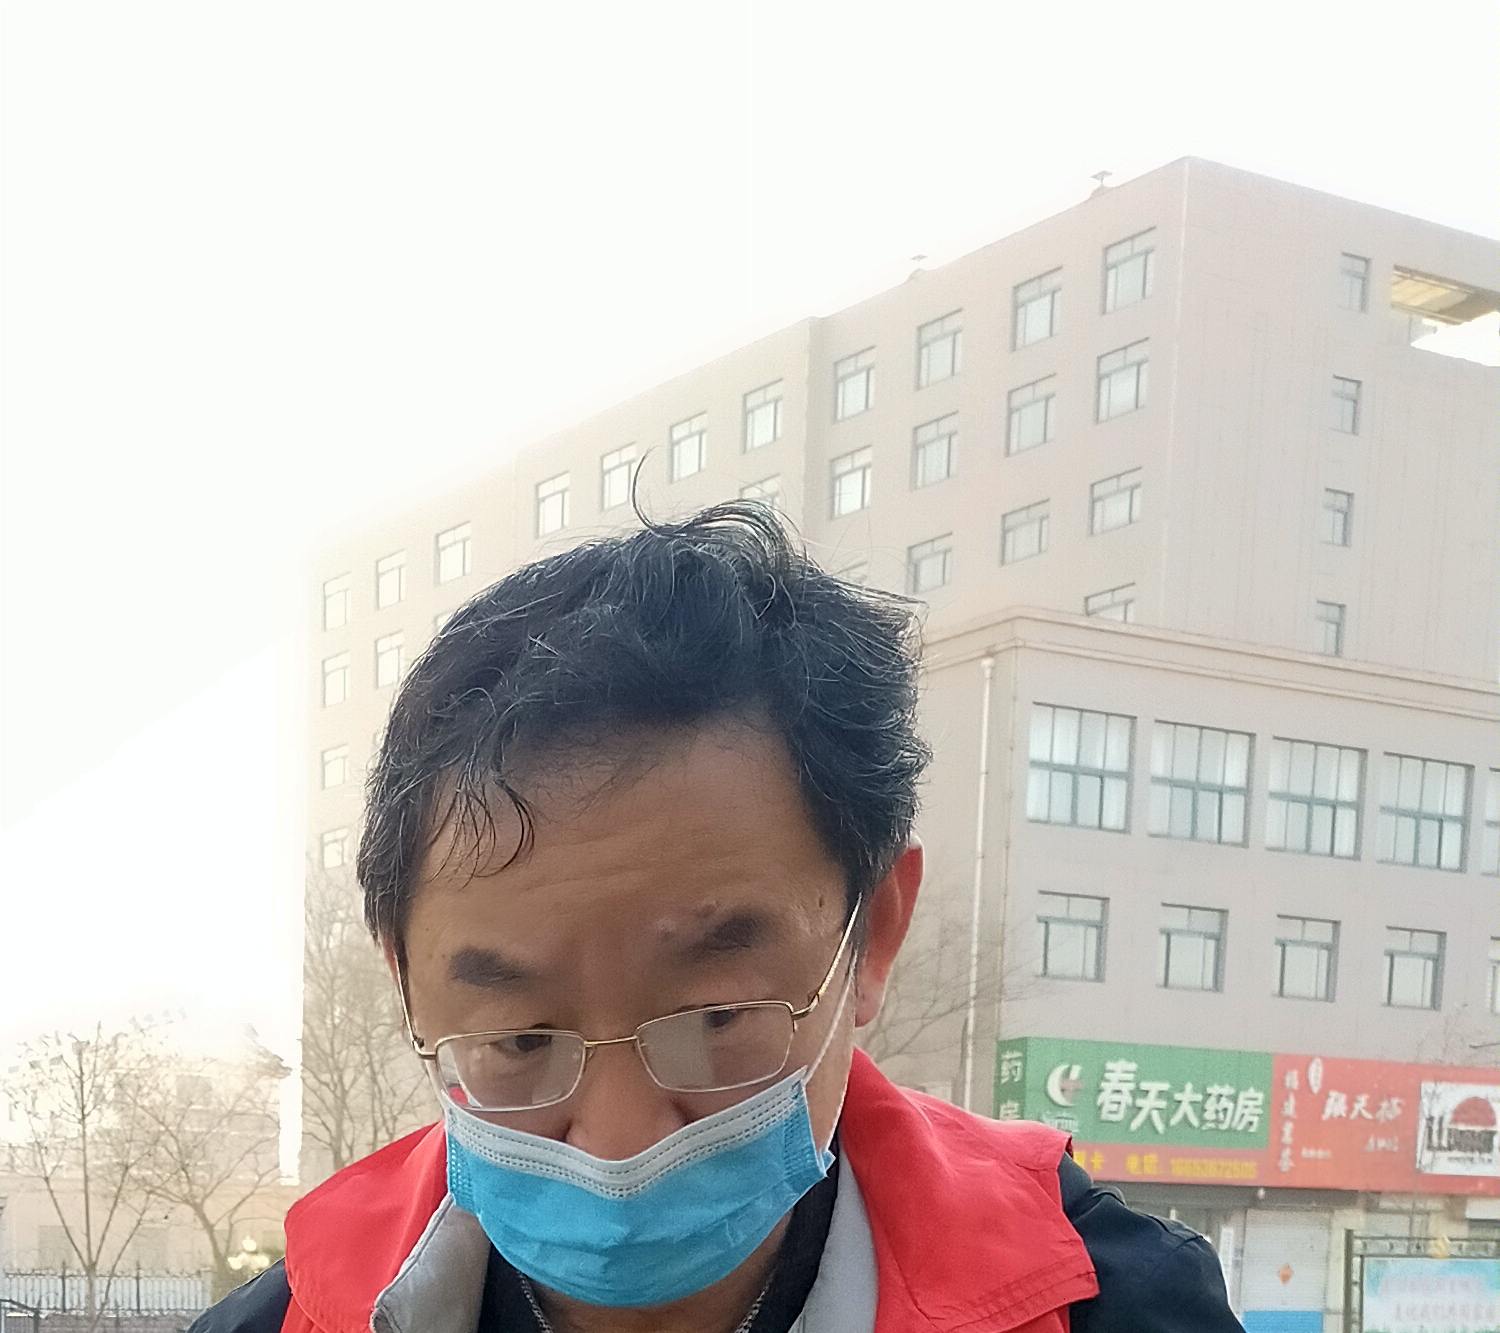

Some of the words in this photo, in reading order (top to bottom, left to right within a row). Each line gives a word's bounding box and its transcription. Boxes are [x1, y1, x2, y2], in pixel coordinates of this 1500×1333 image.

[1097, 1059, 1264, 1134] 春天大药房
